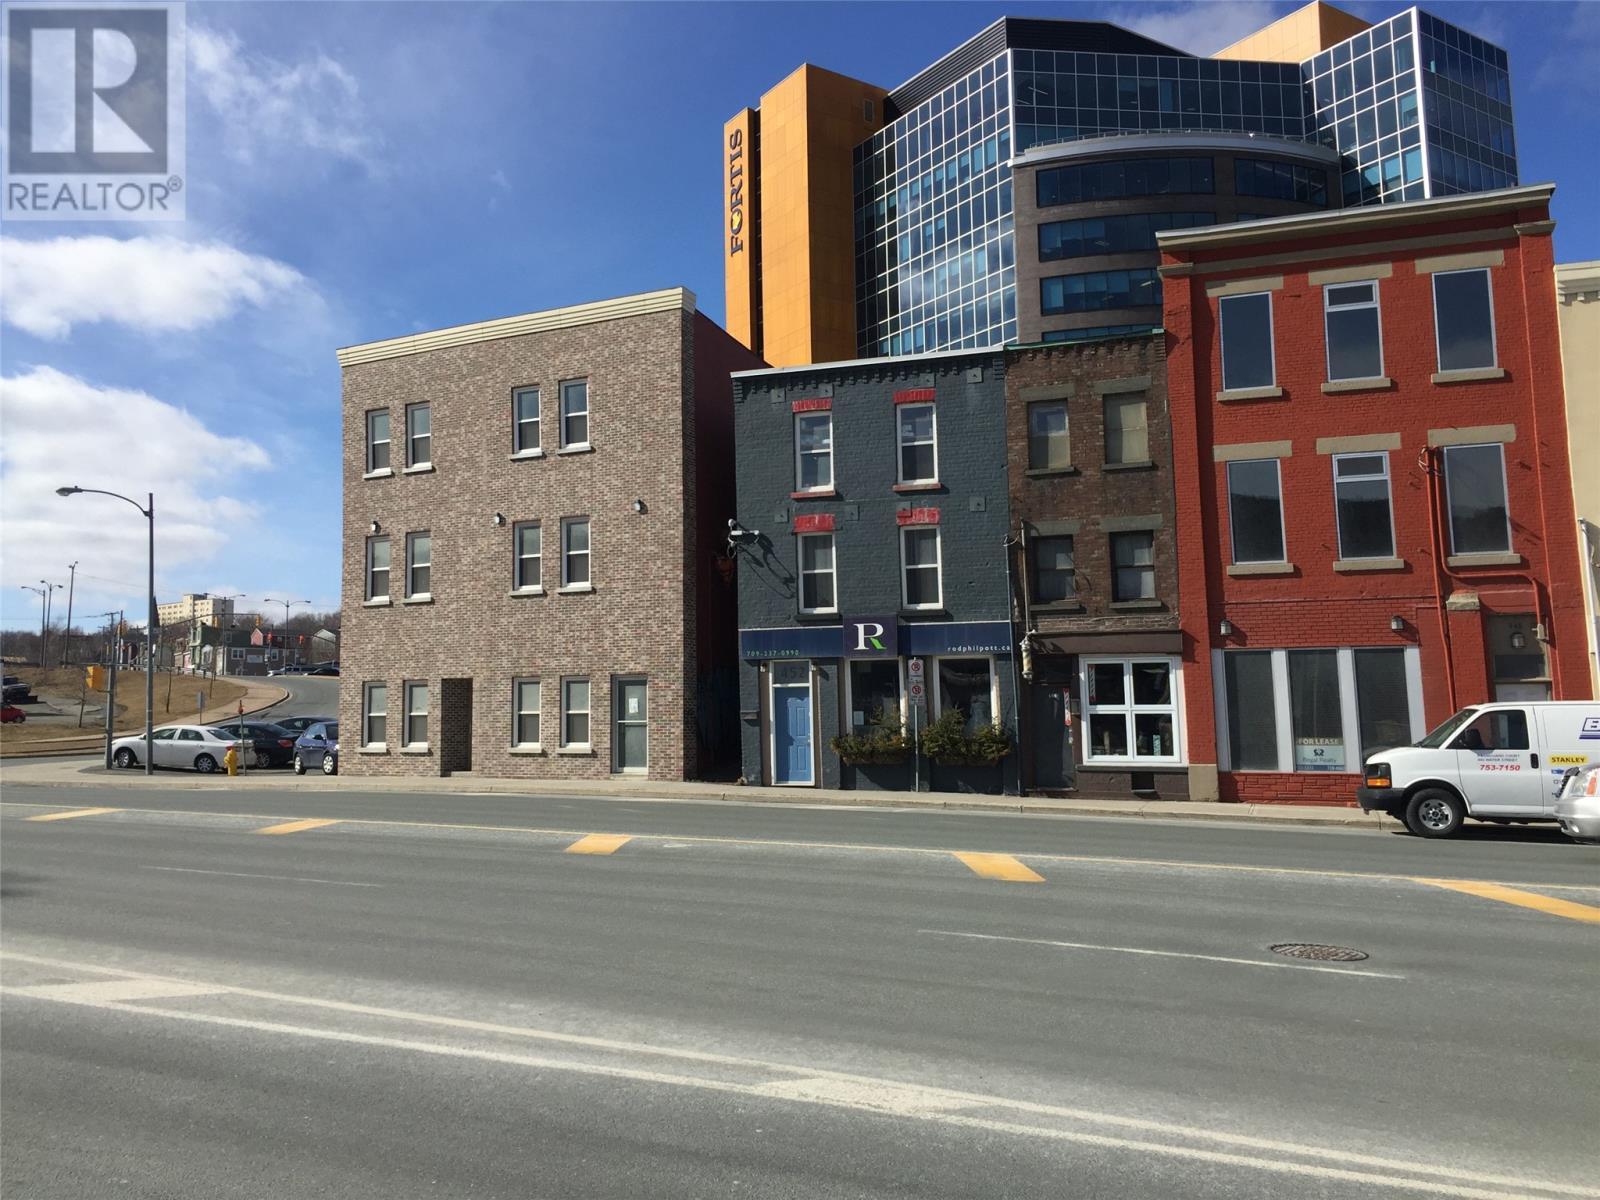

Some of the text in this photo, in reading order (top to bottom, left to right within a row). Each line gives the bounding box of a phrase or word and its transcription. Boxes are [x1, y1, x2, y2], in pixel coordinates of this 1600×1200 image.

[730, 128, 743, 257] FORTIS
[853, 623, 887, 650] R
[1298, 737, 1339, 745] FOR LEASE
